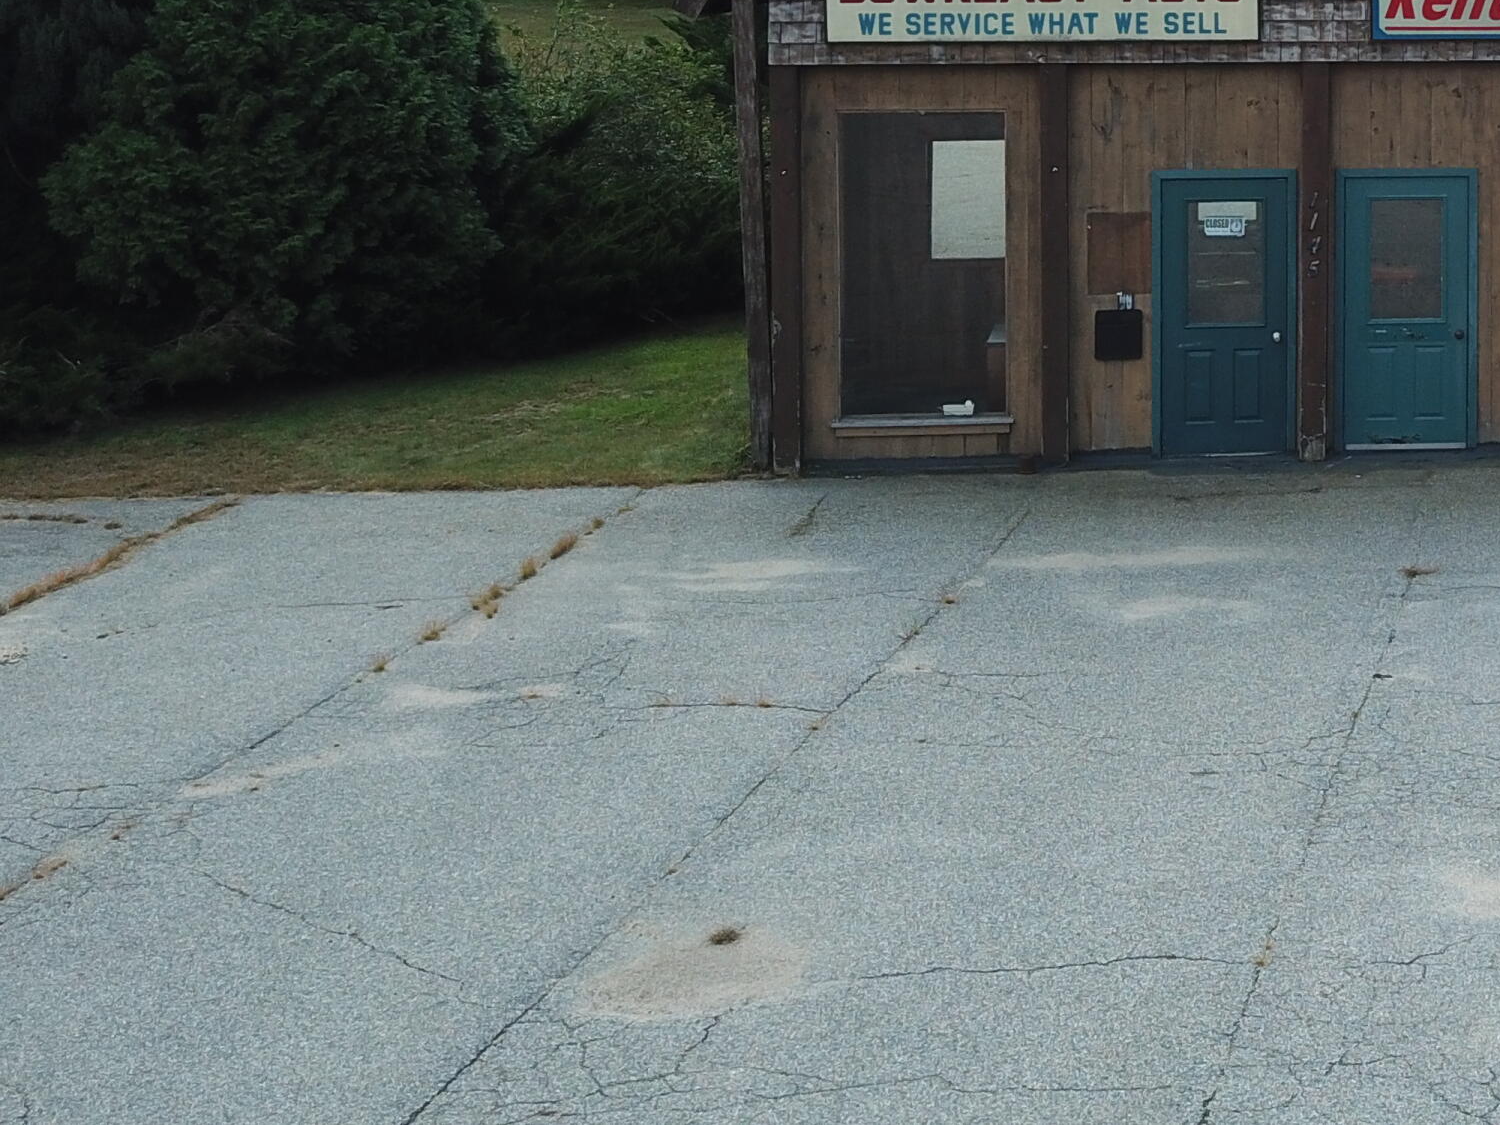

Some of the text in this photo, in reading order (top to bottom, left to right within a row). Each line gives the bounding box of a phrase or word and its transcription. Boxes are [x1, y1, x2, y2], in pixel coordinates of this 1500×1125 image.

[858, 12, 1227, 35] WE SERVICE WHAT WE SELL
[1205, 218, 1230, 228] CLOSED
